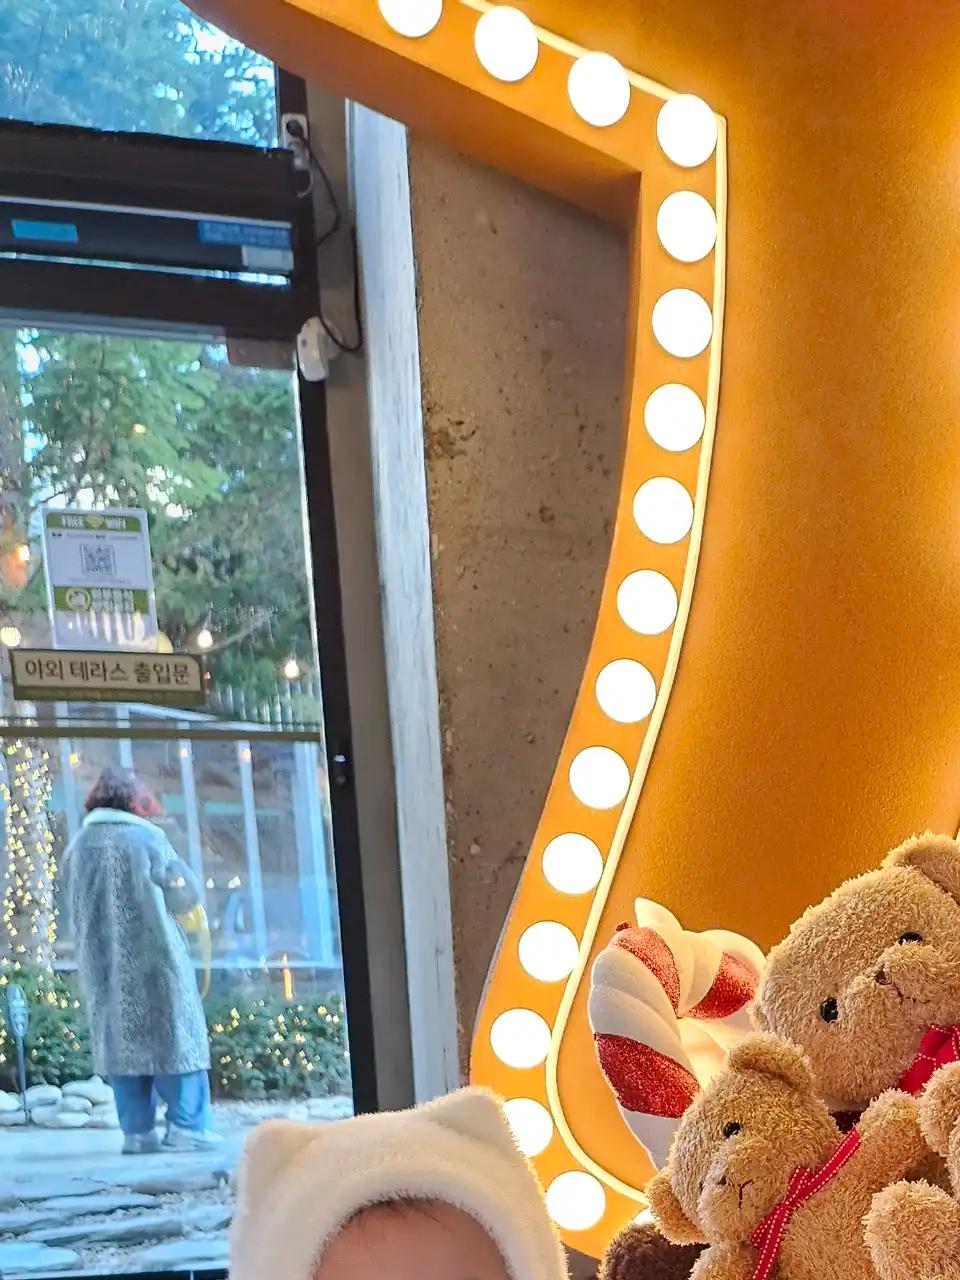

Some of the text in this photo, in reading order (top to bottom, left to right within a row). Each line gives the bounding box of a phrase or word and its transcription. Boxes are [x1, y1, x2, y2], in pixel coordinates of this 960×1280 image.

[25, 658, 189, 685] 야외 테라스 출입문
